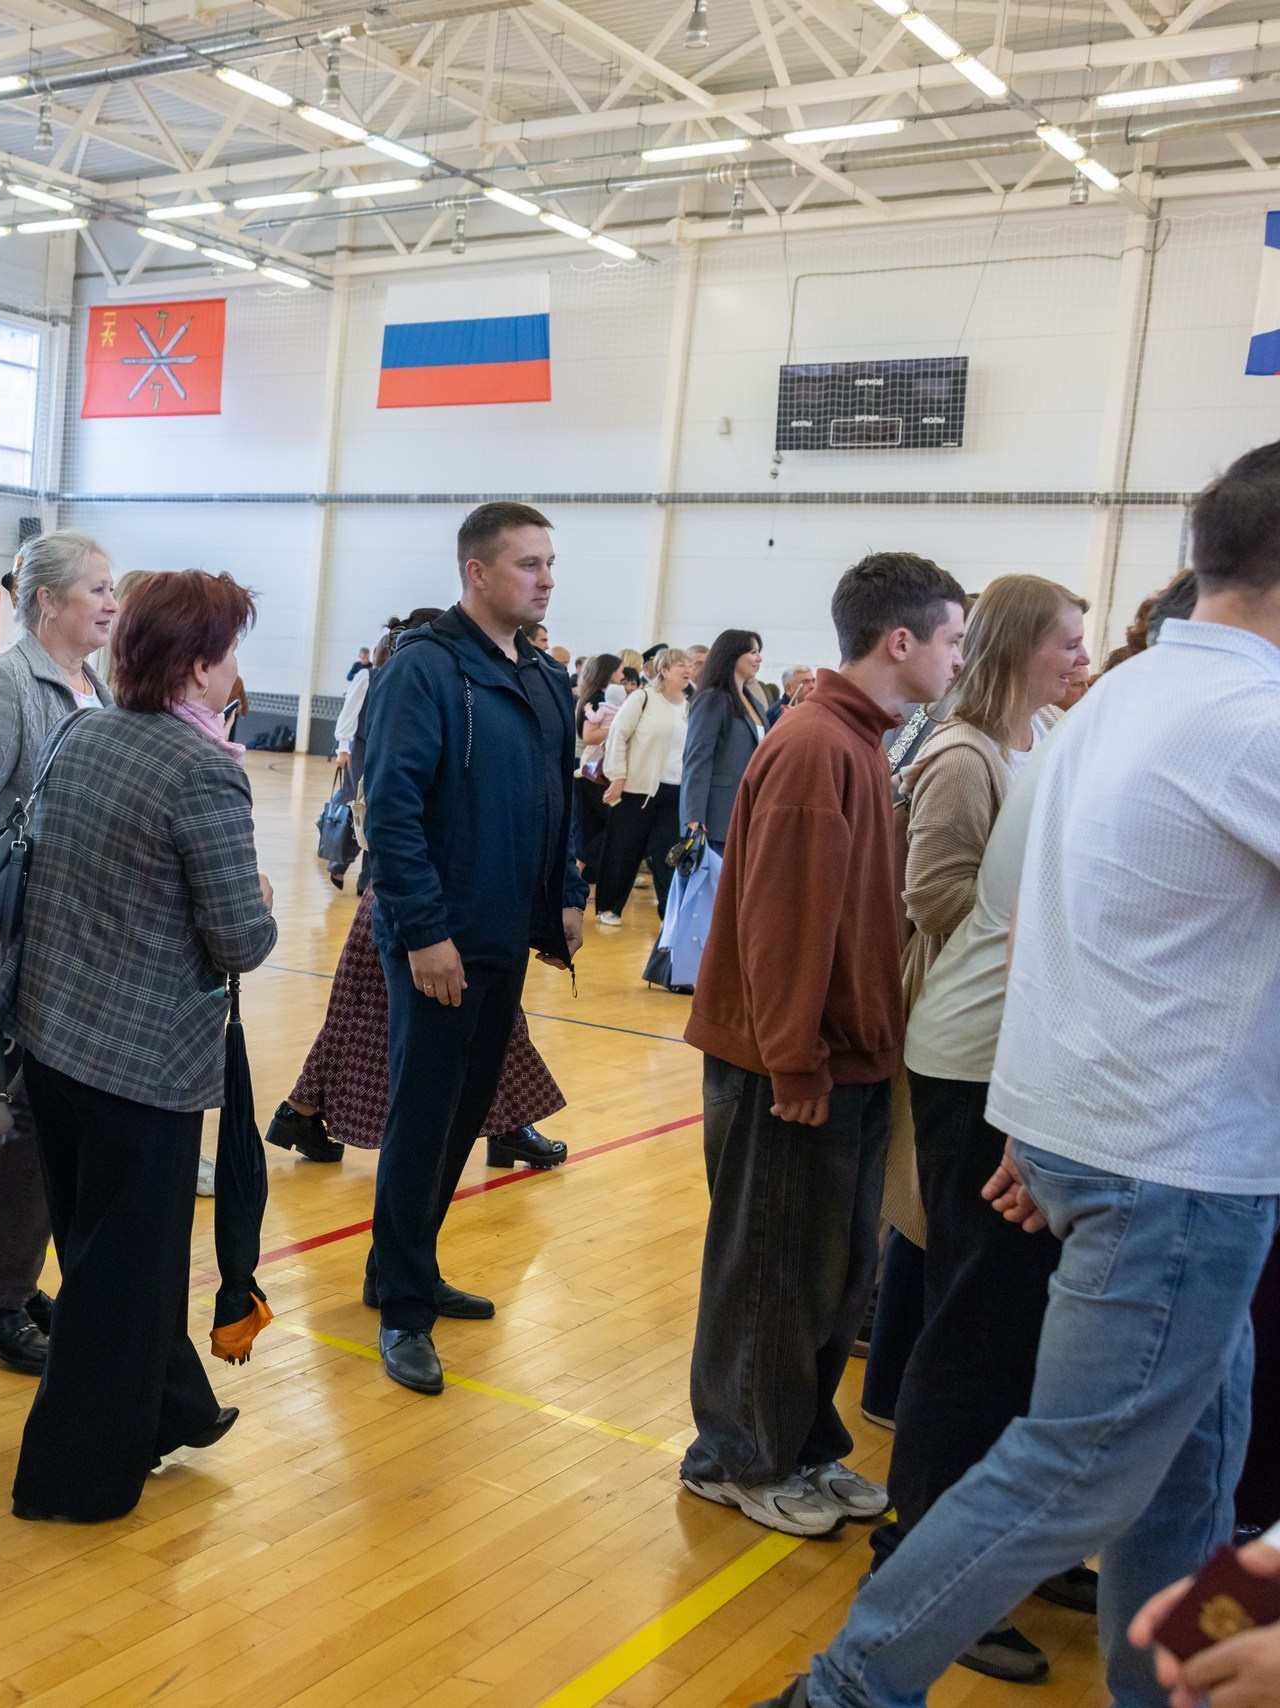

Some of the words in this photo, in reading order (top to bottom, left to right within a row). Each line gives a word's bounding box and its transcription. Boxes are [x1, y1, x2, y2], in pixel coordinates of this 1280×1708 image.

[854, 378, 884, 387] ПЕРИОД
[854, 414, 880, 422] ВРЕМЯ
[922, 416, 946, 424] ФОЛЫ
